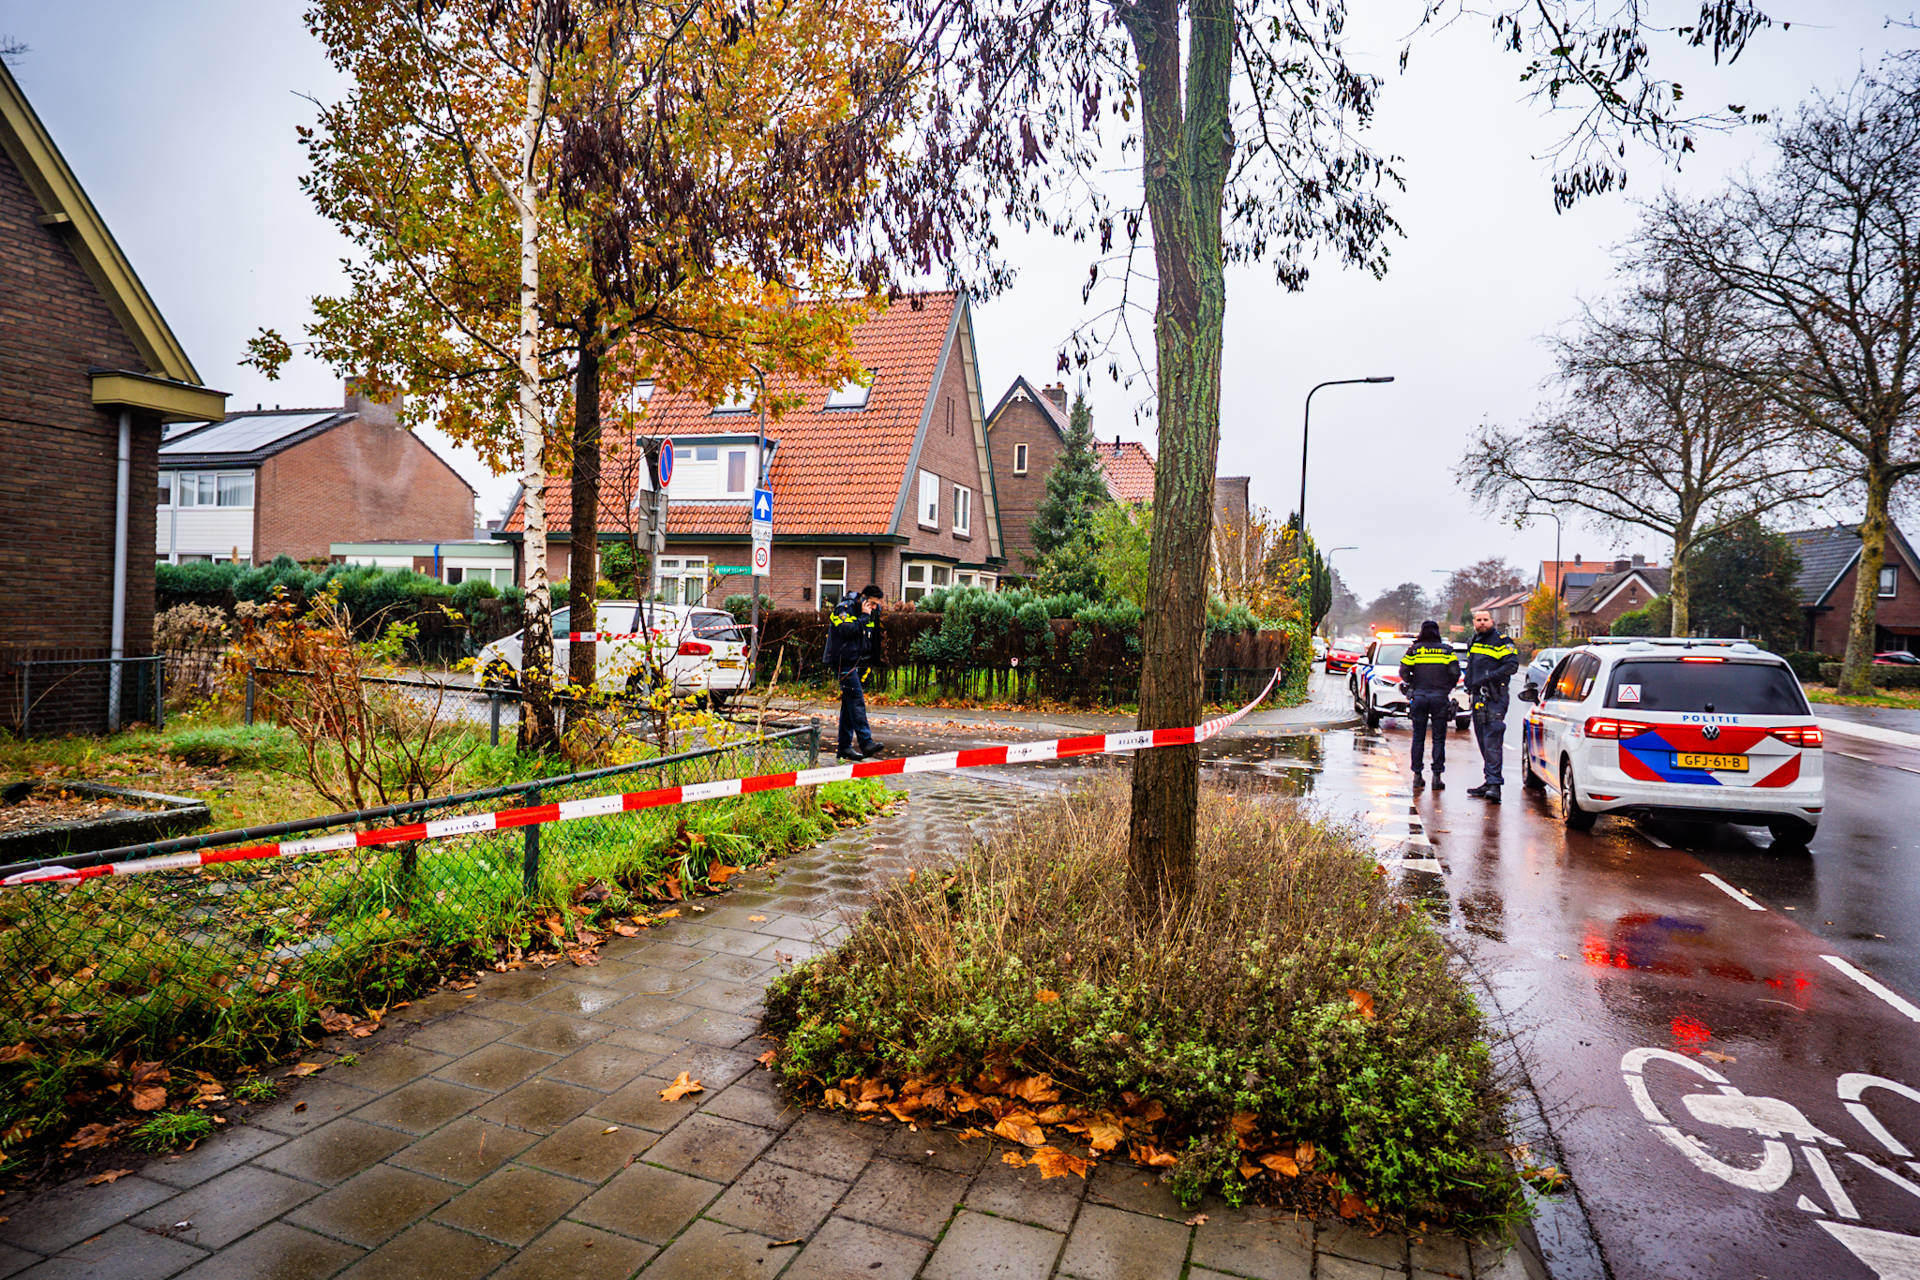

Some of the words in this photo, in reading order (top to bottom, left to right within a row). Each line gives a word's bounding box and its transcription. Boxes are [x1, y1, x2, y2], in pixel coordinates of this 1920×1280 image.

[757, 553, 765, 562] 30
[1682, 715, 1740, 724] POLITIE
[1684, 755, 1740, 768] GFJ-61-B
